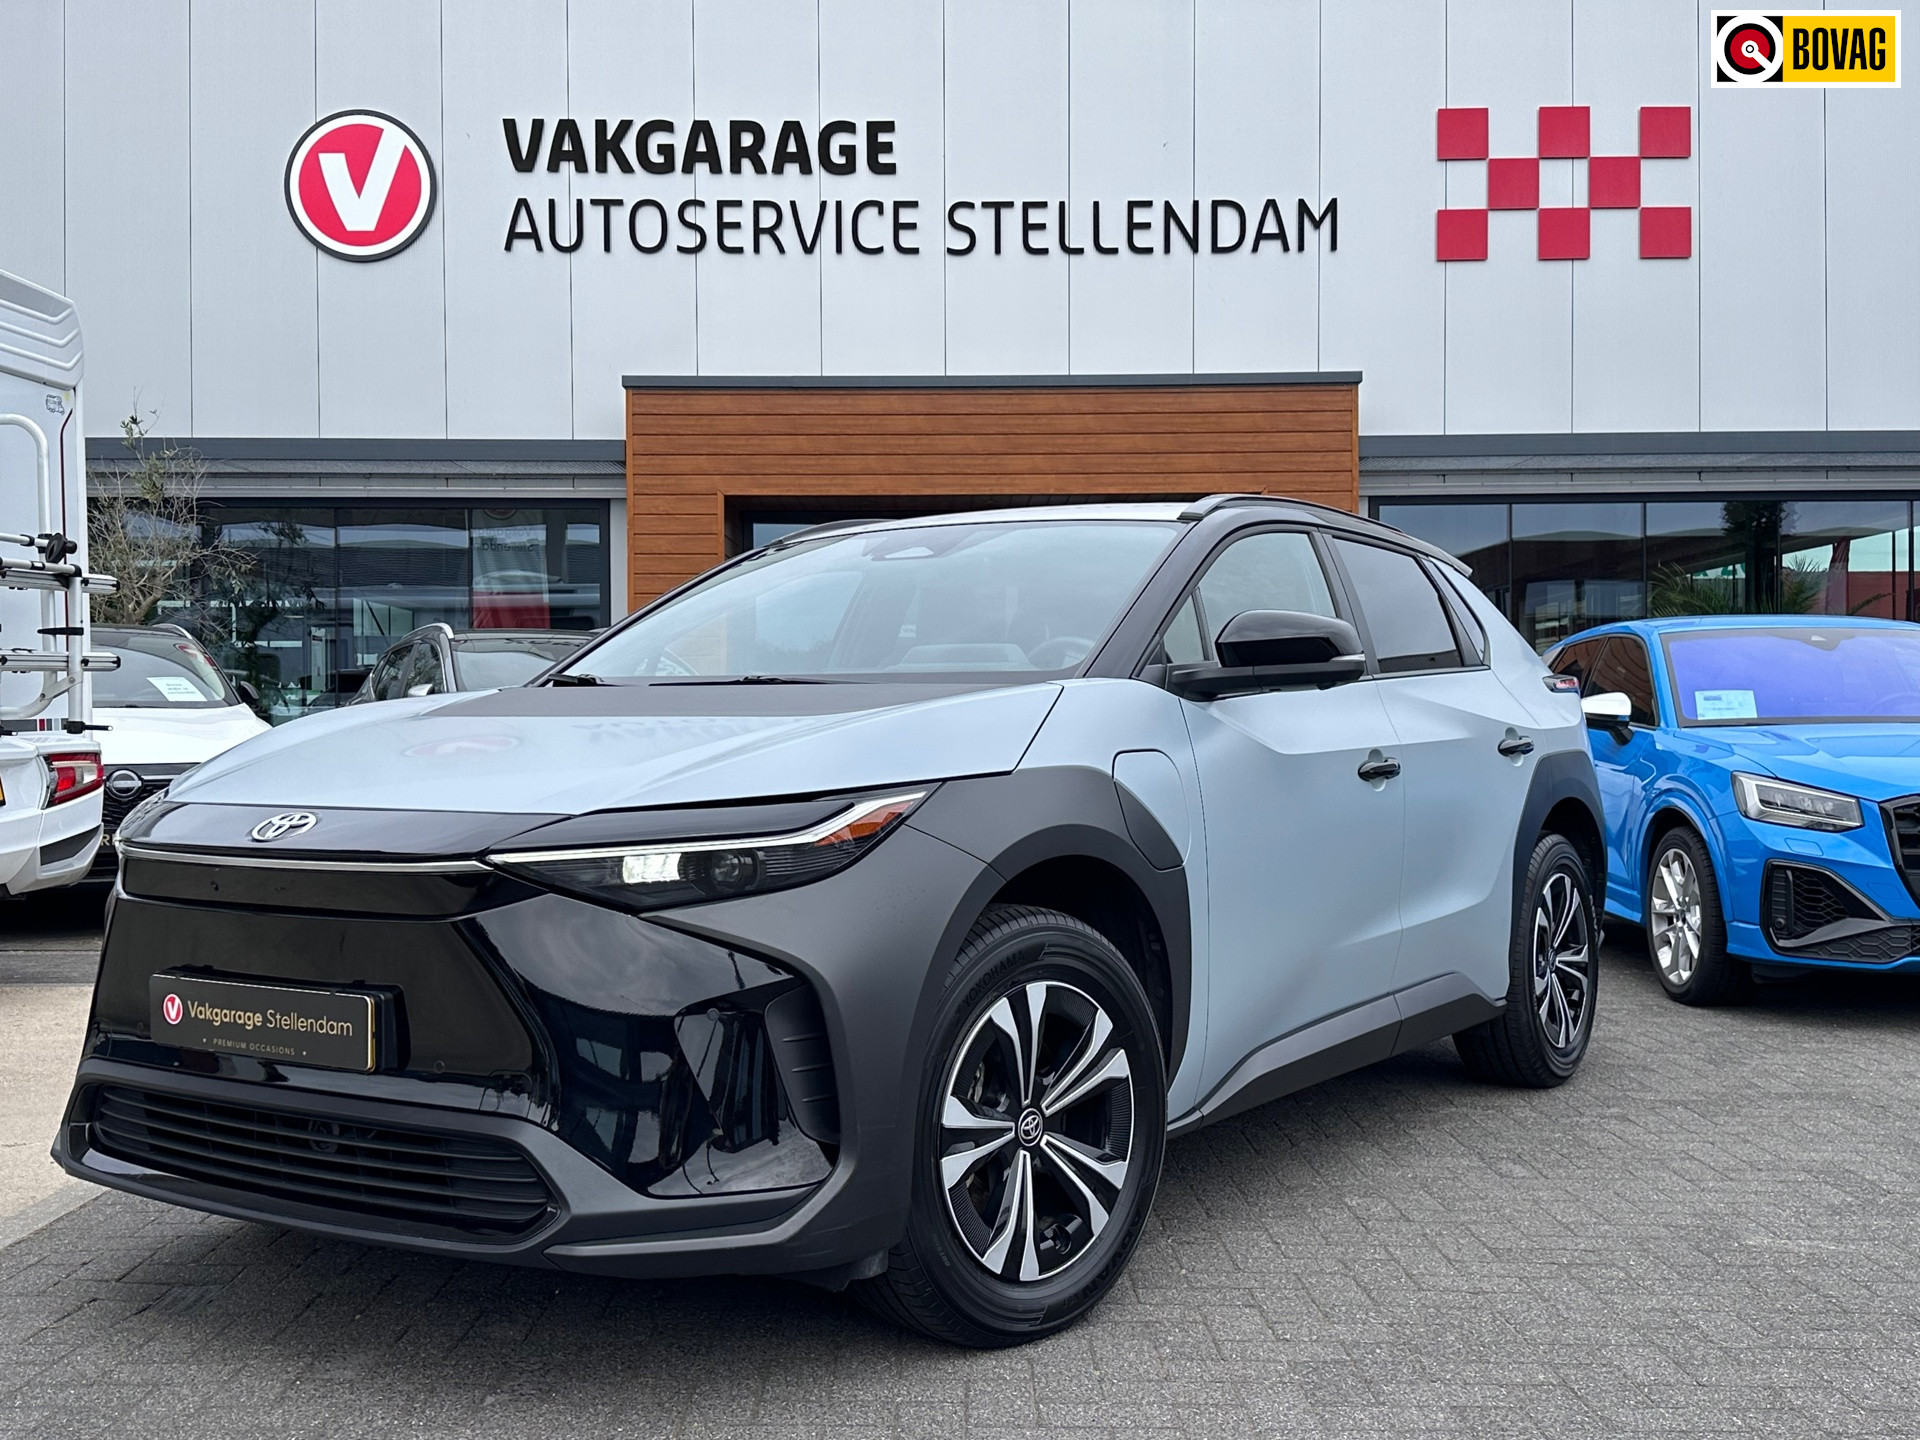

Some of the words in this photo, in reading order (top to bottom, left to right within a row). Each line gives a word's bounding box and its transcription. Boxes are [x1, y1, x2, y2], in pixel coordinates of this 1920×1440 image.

[502, 118, 898, 175] VAKGARAGE
[503, 197, 920, 255] AUTOSERVICE
[946, 197, 1338, 256] STELLENDAM
[963, 950, 1025, 1007] YOKOHAMA
[187, 1000, 263, 1030] Vakgarage
[266, 1009, 353, 1037] Stellendam
[213, 1037, 247, 1050] PREMIUM
[249, 1042, 295, 1056] OCCASIONS
